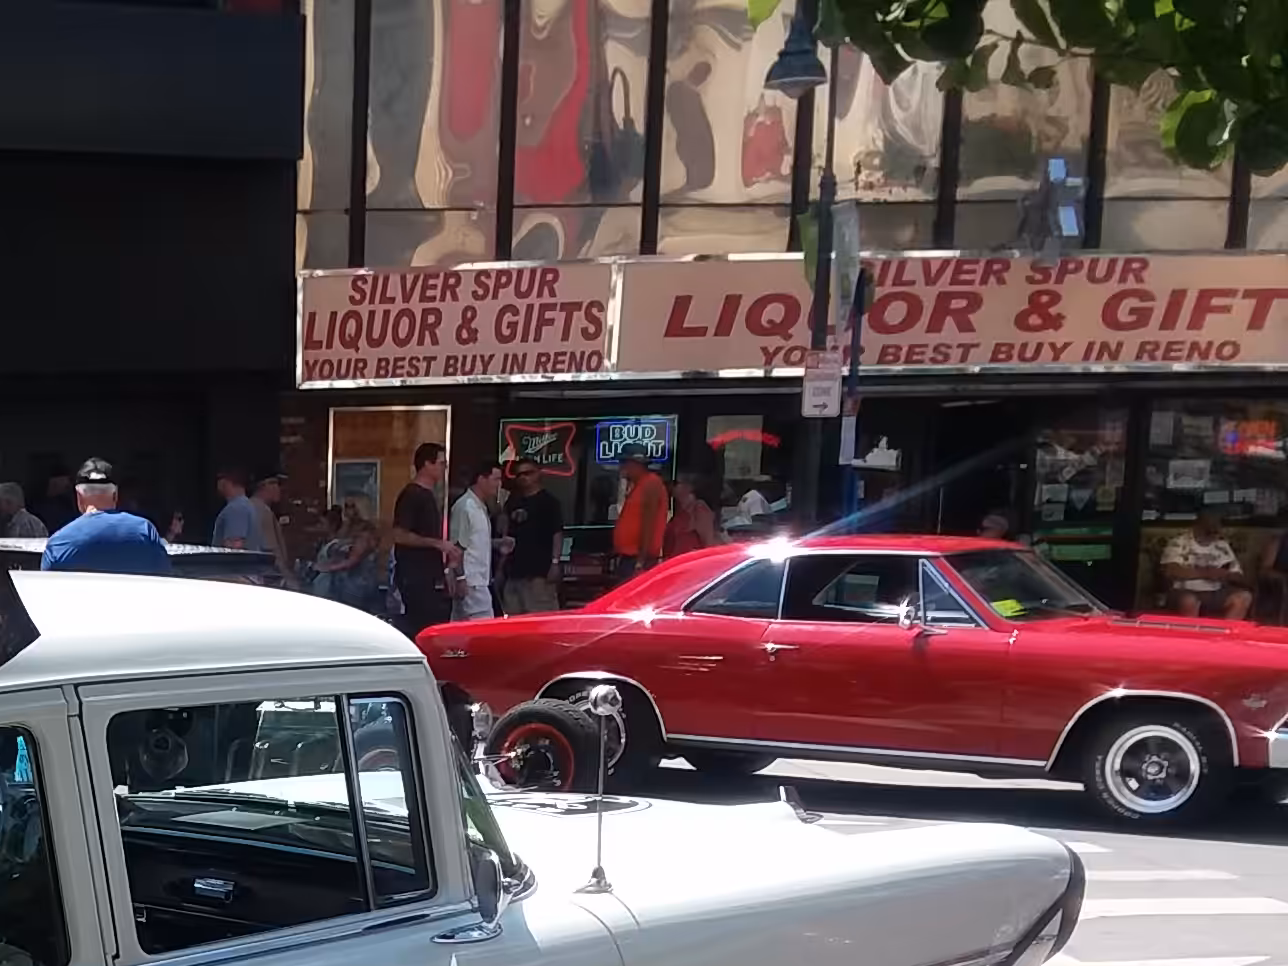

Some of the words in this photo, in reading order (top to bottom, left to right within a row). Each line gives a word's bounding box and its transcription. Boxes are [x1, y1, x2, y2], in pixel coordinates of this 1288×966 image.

[1025, 256, 1150, 286] SPUR
[348, 270, 462, 306] SILVER
[471, 267, 560, 301] SPUR
[1014, 289, 1066, 333] &
[1101, 288, 1288, 332] GIFT
[303, 307, 443, 353] LIQUOR
[455, 305, 479, 346] &
[494, 300, 606, 345] GIFTS
[304, 357, 369, 381] YOUR
[374, 355, 438, 379] BEST
[443, 352, 496, 377] BUY
[501, 351, 529, 374] IN
[535, 349, 604, 373] RENO
[759, 345, 866, 367] YOR
[876, 343, 980, 365] BEST
[989, 341, 1073, 364] BUY
[1081, 340, 1124, 363] IN
[1135, 340, 1241, 362] RENO
[609, 424, 657, 442] BUD
[543, 453, 563, 464] LIFE
[599, 440, 665, 459] LIT
